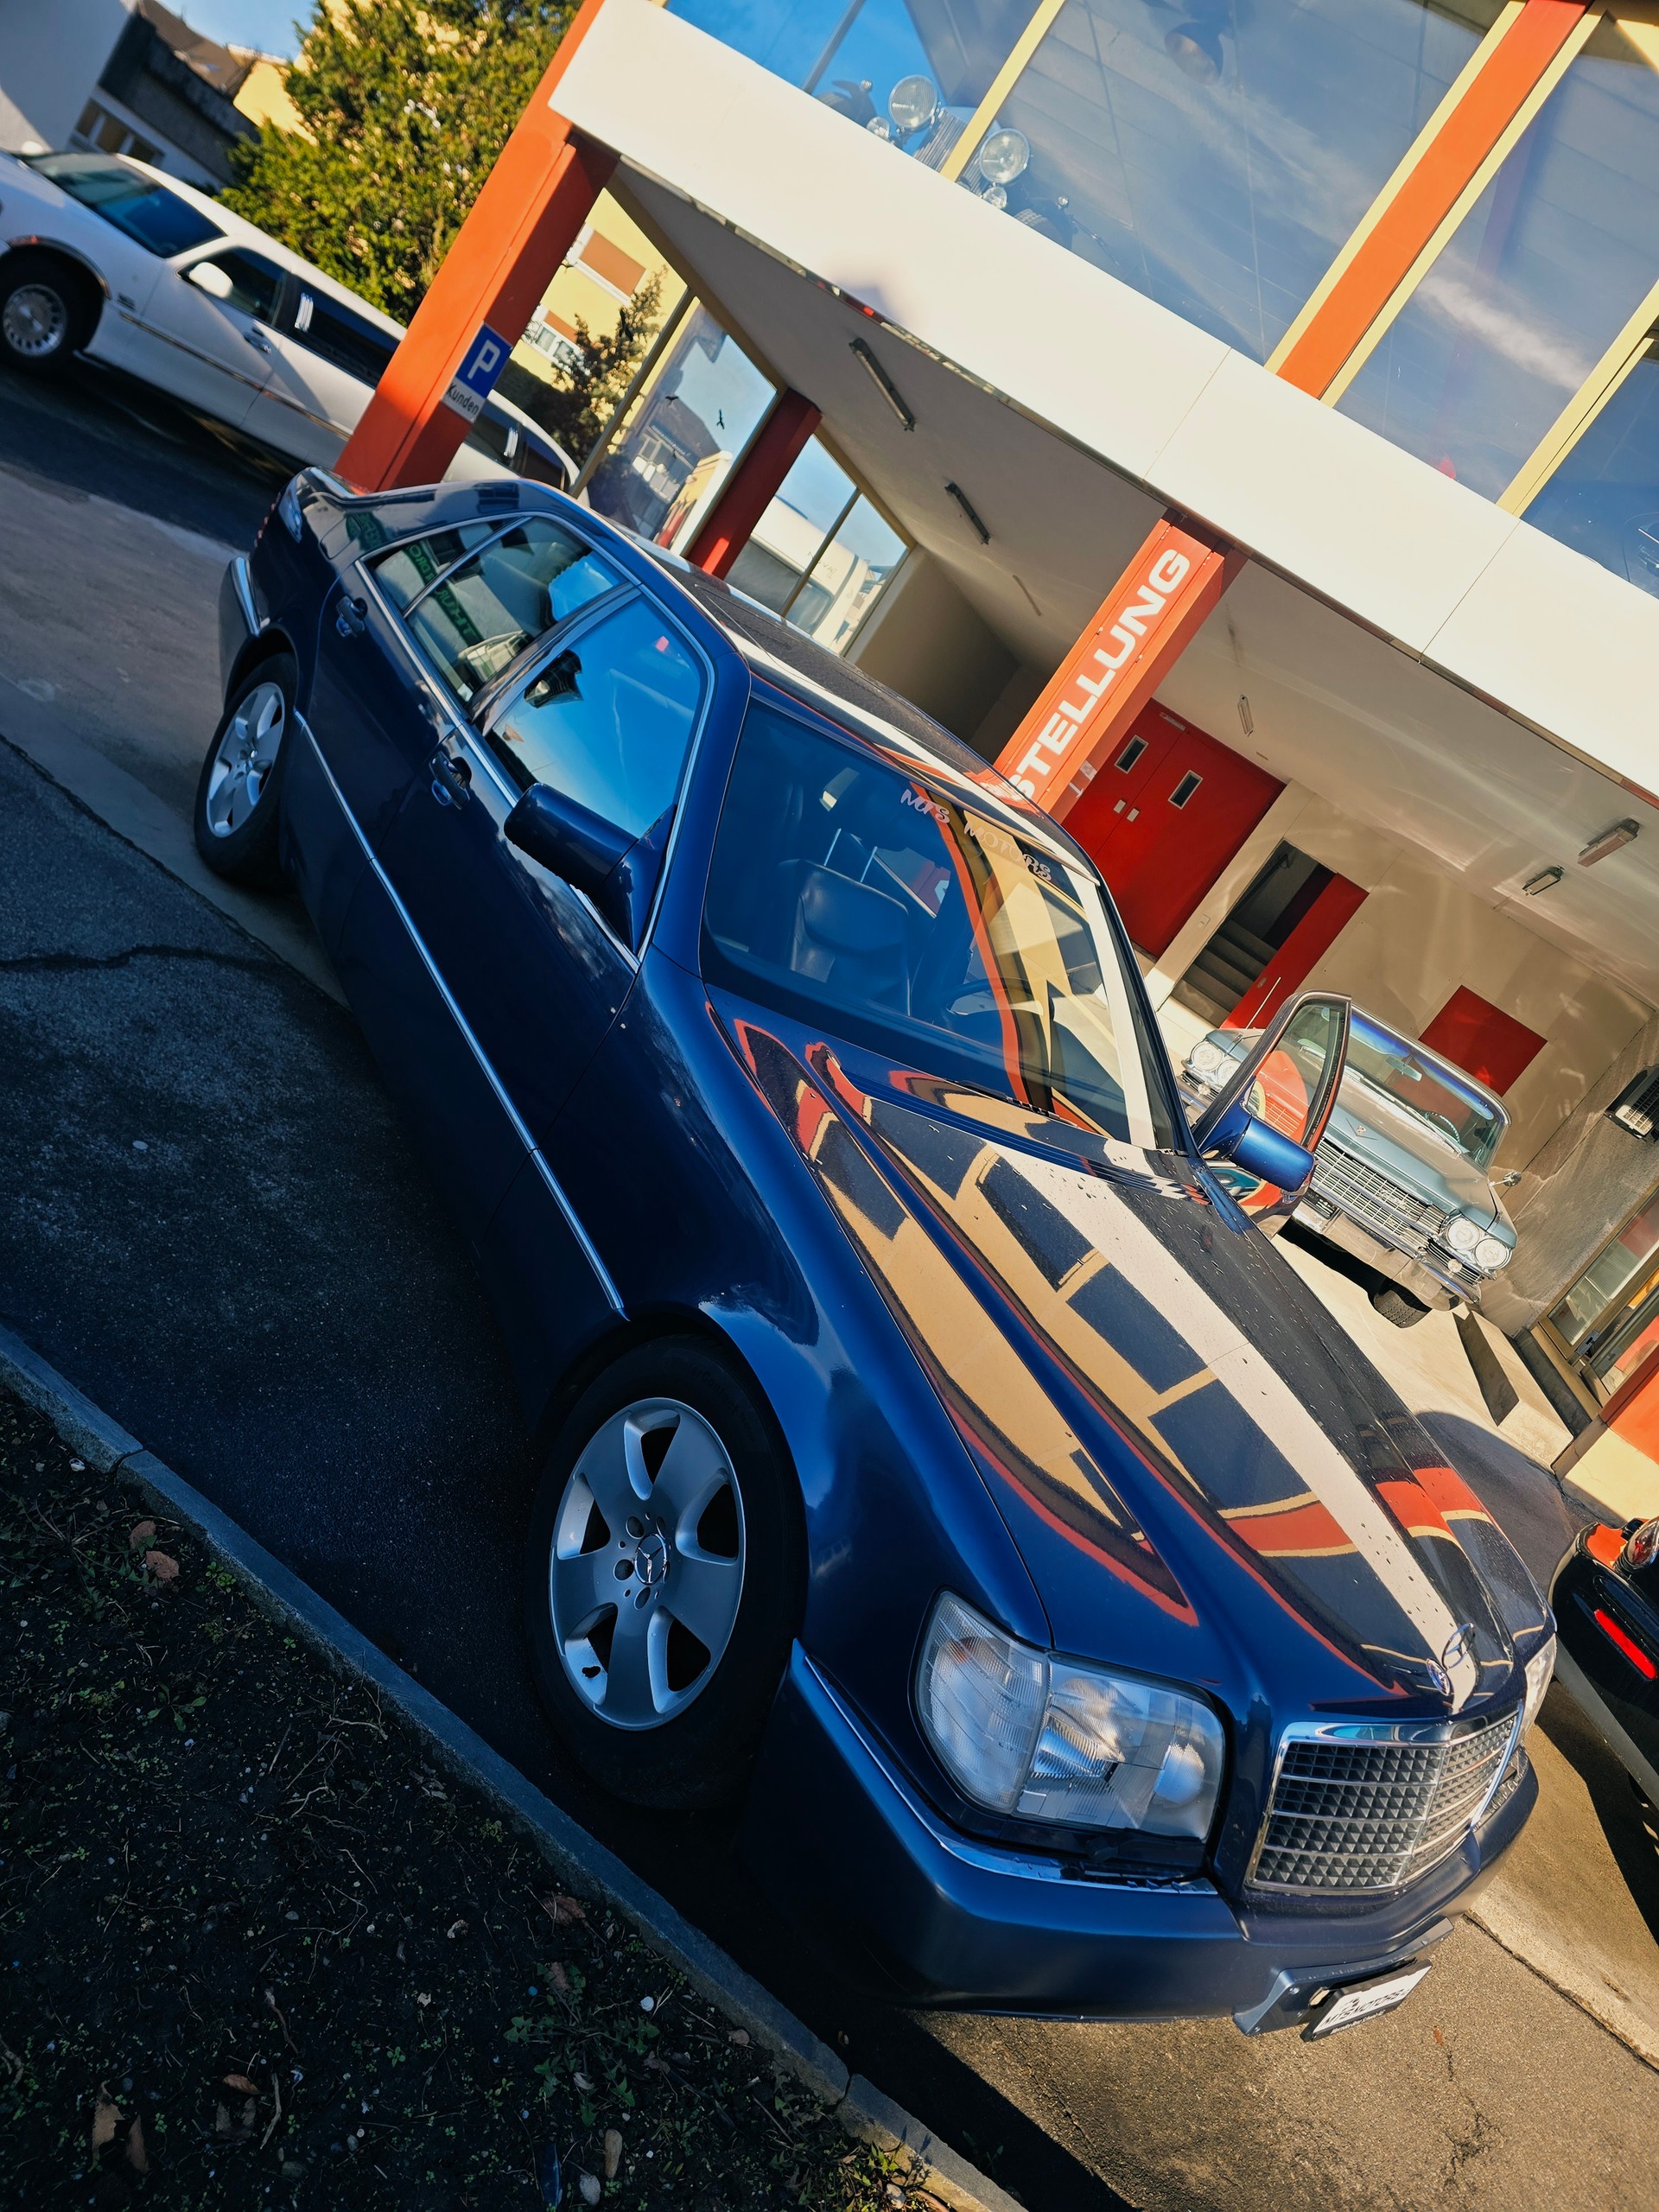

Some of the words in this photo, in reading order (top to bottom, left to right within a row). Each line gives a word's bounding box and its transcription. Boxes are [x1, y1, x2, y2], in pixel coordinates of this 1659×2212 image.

[467, 340, 501, 380] P
[446, 383, 480, 416] Kunden
[963, 822, 1052, 880] MOTORS
